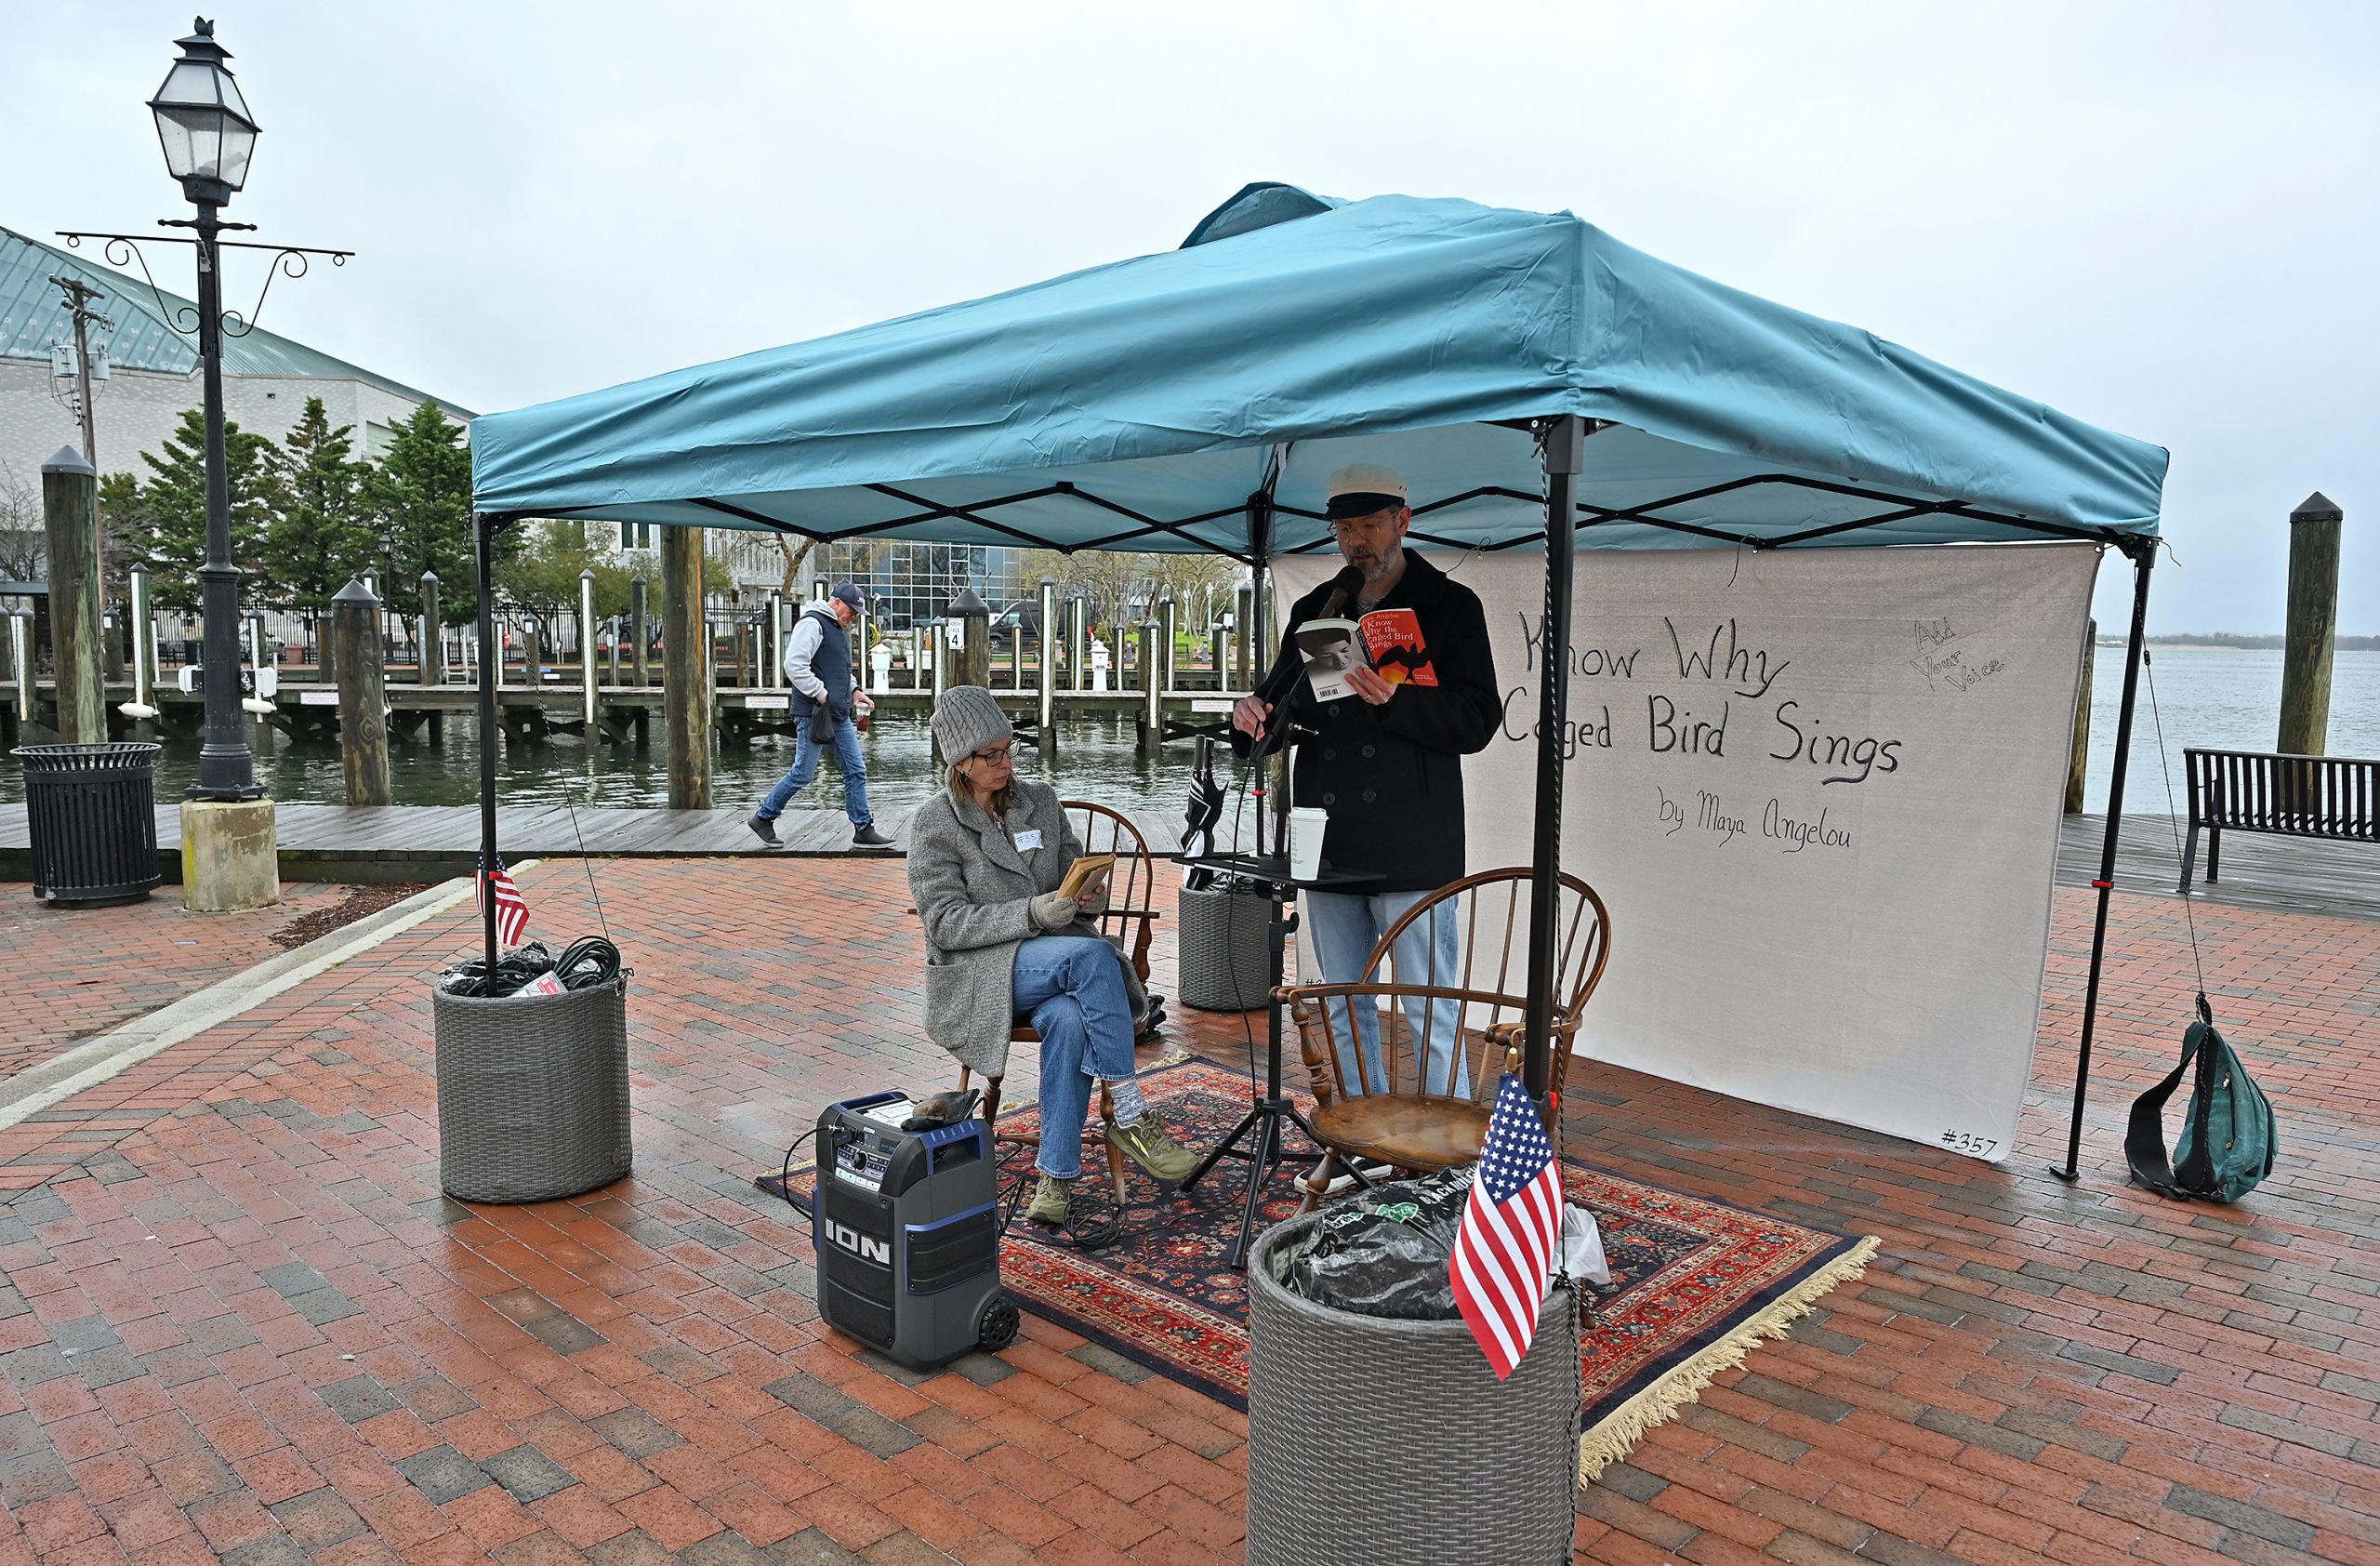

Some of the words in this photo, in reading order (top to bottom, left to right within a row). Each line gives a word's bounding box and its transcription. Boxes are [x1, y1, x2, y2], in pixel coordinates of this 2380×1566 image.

[1365, 628, 1382, 639] Why
[1367, 633, 1392, 645] Caged
[1395, 632, 1413, 641] Bird
[1368, 619, 1393, 630] Know
[1915, 616, 1956, 651] Add
[951, 633, 959, 646] 4
[1369, 641, 1392, 651] Sings
[1664, 617, 1791, 698] Why
[1910, 650, 1962, 693] Your
[1945, 659, 2004, 692] Voice
[1502, 685, 1613, 761] Cged
[1647, 694, 1728, 757] Bird
[1769, 699, 1902, 786] Sings
[1657, 786, 1684, 836] by
[1697, 790, 1747, 848] Maya
[1763, 798, 1850, 854] Angelou
[1016, 832, 1041, 846] #357
[1940, 1128, 1998, 1157] #357
[1419, 1184, 1457, 1204] BLACK
[826, 1217, 890, 1265] ION
